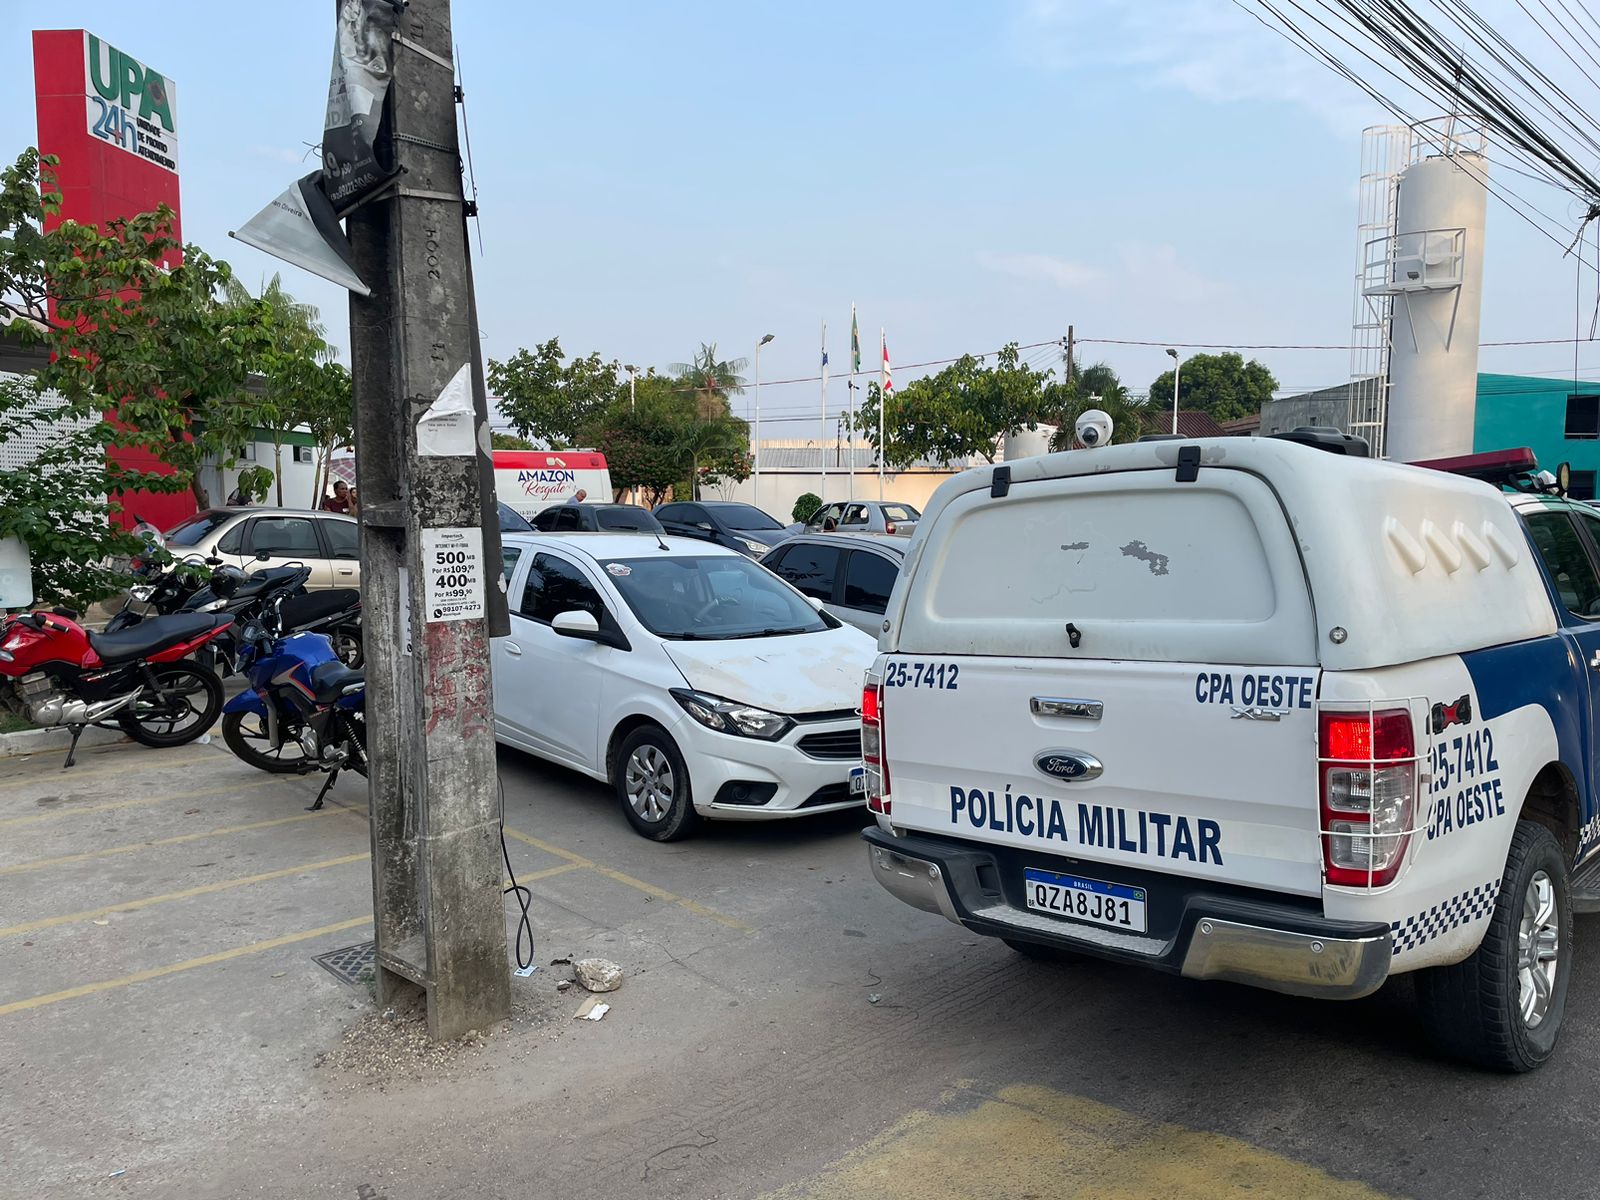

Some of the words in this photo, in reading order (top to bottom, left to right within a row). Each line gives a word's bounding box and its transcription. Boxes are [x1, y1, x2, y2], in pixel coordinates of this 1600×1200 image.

[88, 33, 175, 133] UPA
[92, 96, 138, 152] 24h
[137, 131, 146, 143] DE
[518, 470, 575, 482] AMAZON
[521, 479, 567, 501] Resgate
[436, 551, 466, 565] 500
[886, 662, 959, 689] 25-7412
[1195, 672, 1234, 704] CPA
[1241, 674, 1314, 709] OESTE
[1046, 757, 1075, 774] Ford
[1427, 796, 1453, 841] CPA
[1456, 778, 1505, 829] OESTE
[950, 784, 1068, 842] POLÍCIA
[1077, 803, 1224, 866] MILITAR
[1073, 880, 1094, 891] BRASIL
[1035, 884, 1132, 926] QZA8J81
